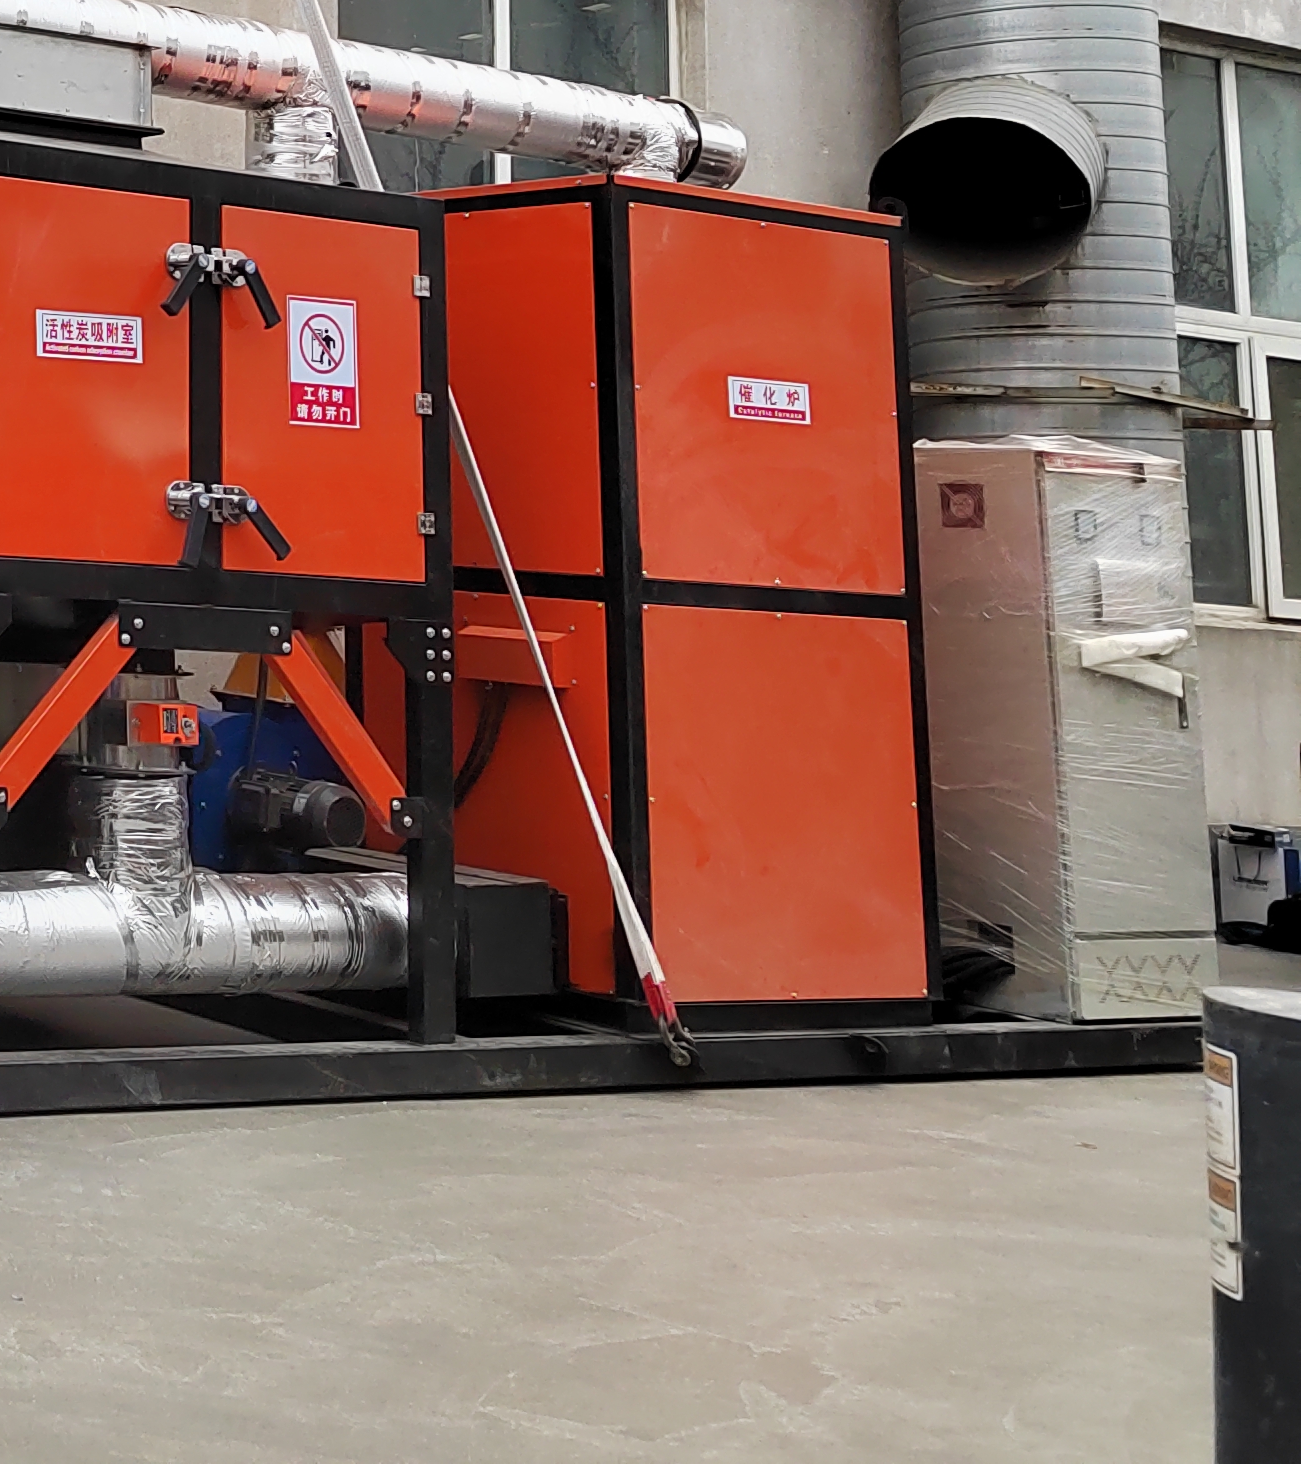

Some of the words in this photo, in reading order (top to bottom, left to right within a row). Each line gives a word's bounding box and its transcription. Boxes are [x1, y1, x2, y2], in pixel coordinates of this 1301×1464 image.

[45, 318, 134, 344] 活性炭吸附室
[303, 386, 343, 404] 工作时
[738, 383, 800, 407] 催化炉
[297, 403, 351, 423] 请勿开门
